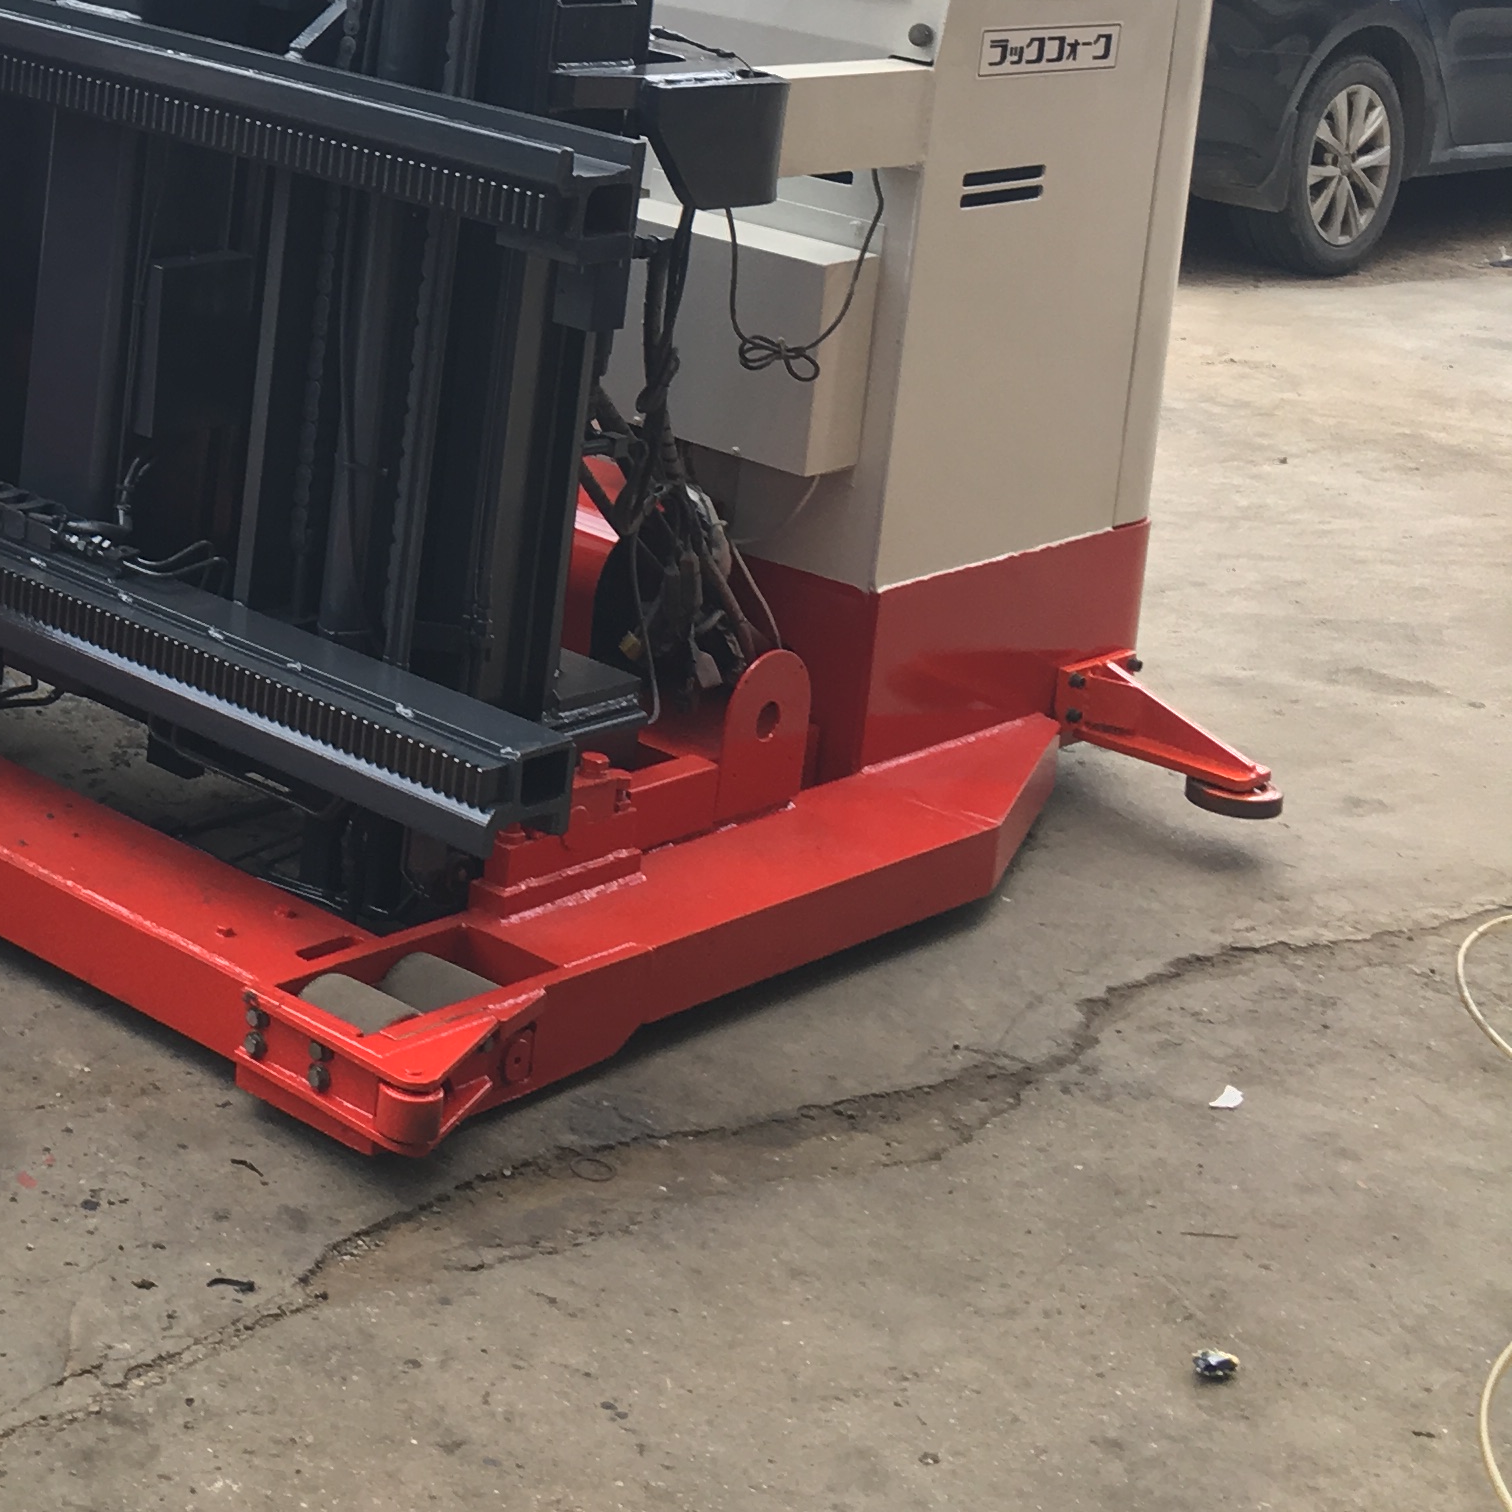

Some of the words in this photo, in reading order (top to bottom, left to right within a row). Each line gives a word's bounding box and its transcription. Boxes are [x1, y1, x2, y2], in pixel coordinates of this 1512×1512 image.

[987, 33, 1114, 67] ラックフォーク
